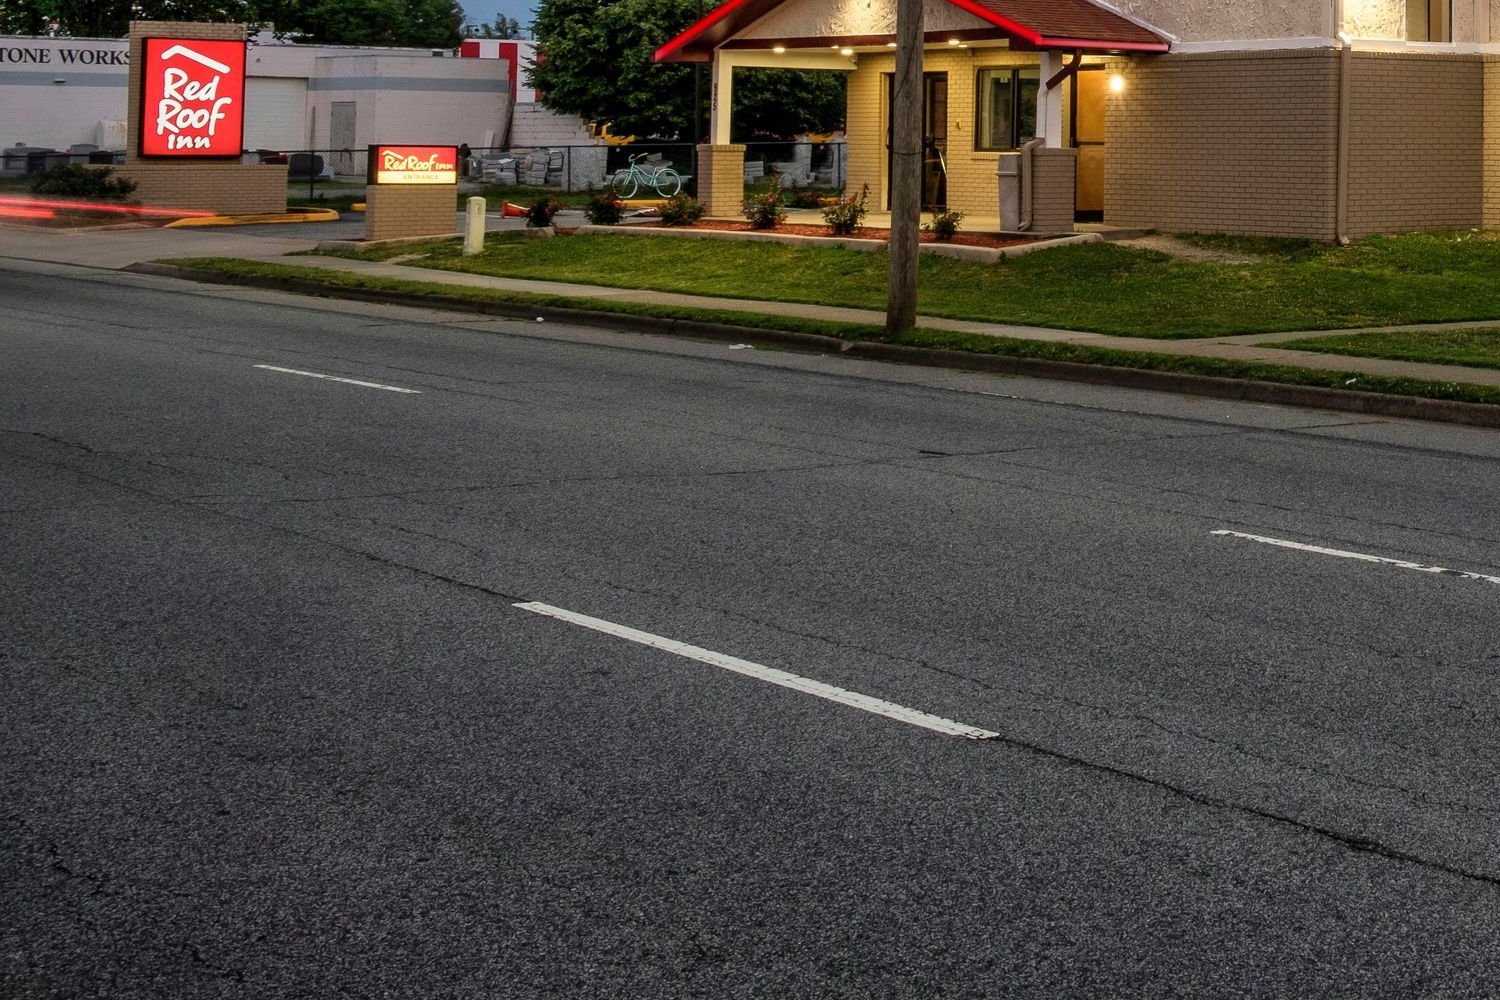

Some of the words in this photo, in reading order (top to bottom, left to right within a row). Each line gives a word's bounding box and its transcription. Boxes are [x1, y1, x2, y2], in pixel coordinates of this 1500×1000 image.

[164, 68, 220, 102] Red
[156, 97, 232, 136] Roof
[384, 155, 407, 171] Red
[407, 154, 438, 172] Roof
